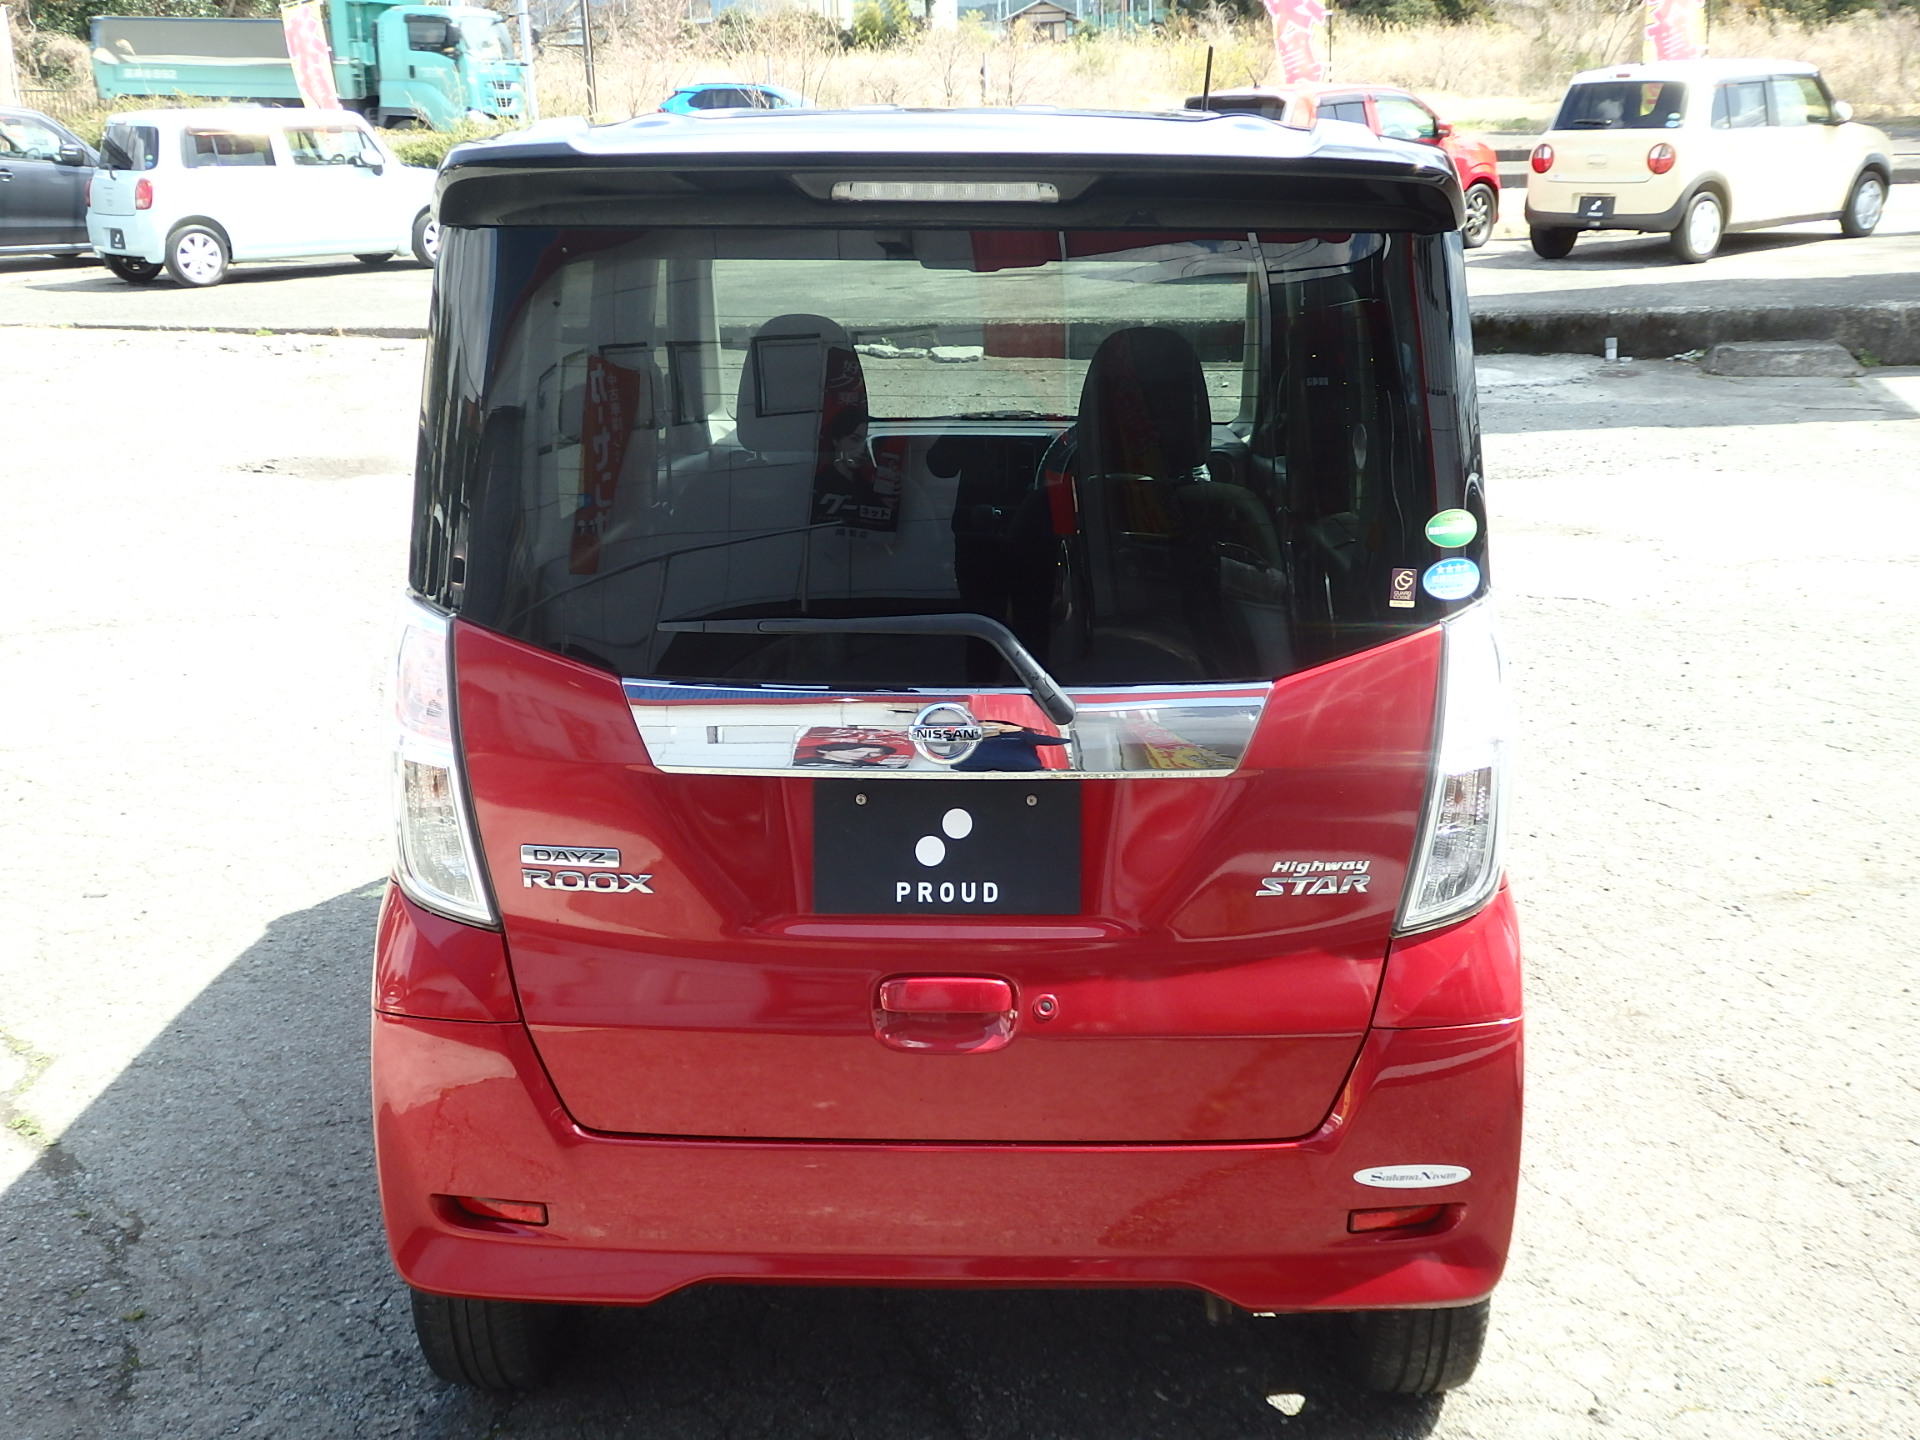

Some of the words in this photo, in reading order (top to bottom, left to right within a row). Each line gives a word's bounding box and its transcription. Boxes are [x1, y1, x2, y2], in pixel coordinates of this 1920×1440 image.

[916, 729, 974, 739] NISSAN
[533, 849, 606, 864] DAYZ
[1271, 860, 1371, 877] Highway
[521, 868, 655, 894] ROOX
[1255, 875, 1371, 897] STAR
[896, 881, 999, 903] PROUD
[1418, 1171, 1457, 1181] Nissan
